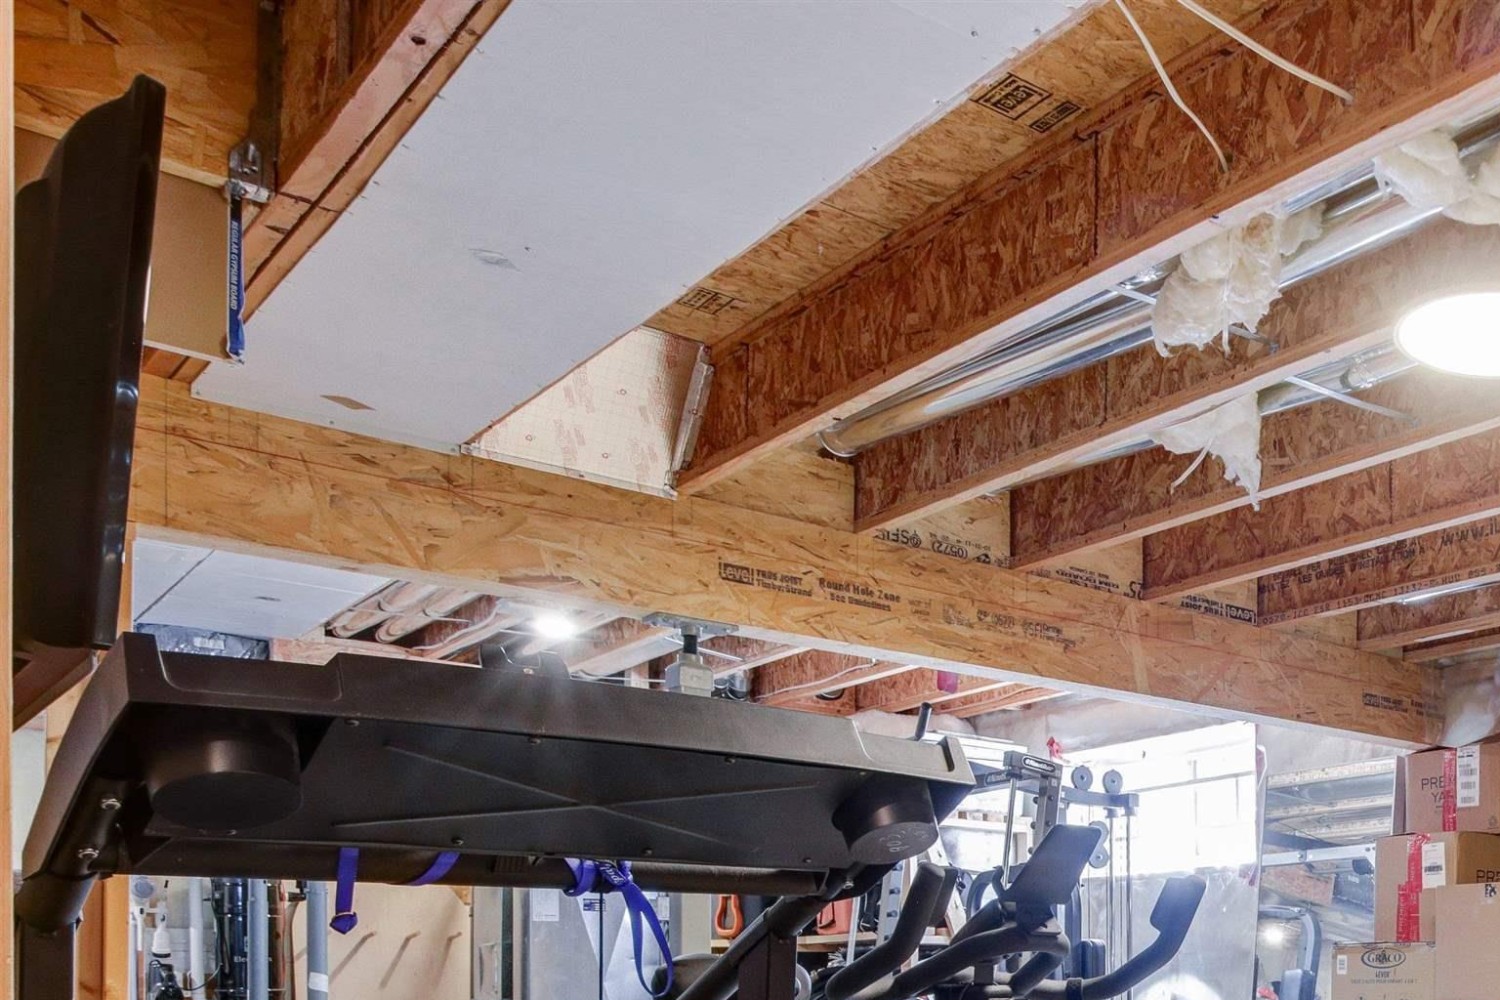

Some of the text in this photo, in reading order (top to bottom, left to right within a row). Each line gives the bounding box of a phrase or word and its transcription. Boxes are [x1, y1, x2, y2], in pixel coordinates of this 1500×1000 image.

[819, 577, 901, 603] Round Hole Zone
[829, 592, 846, 603] See
